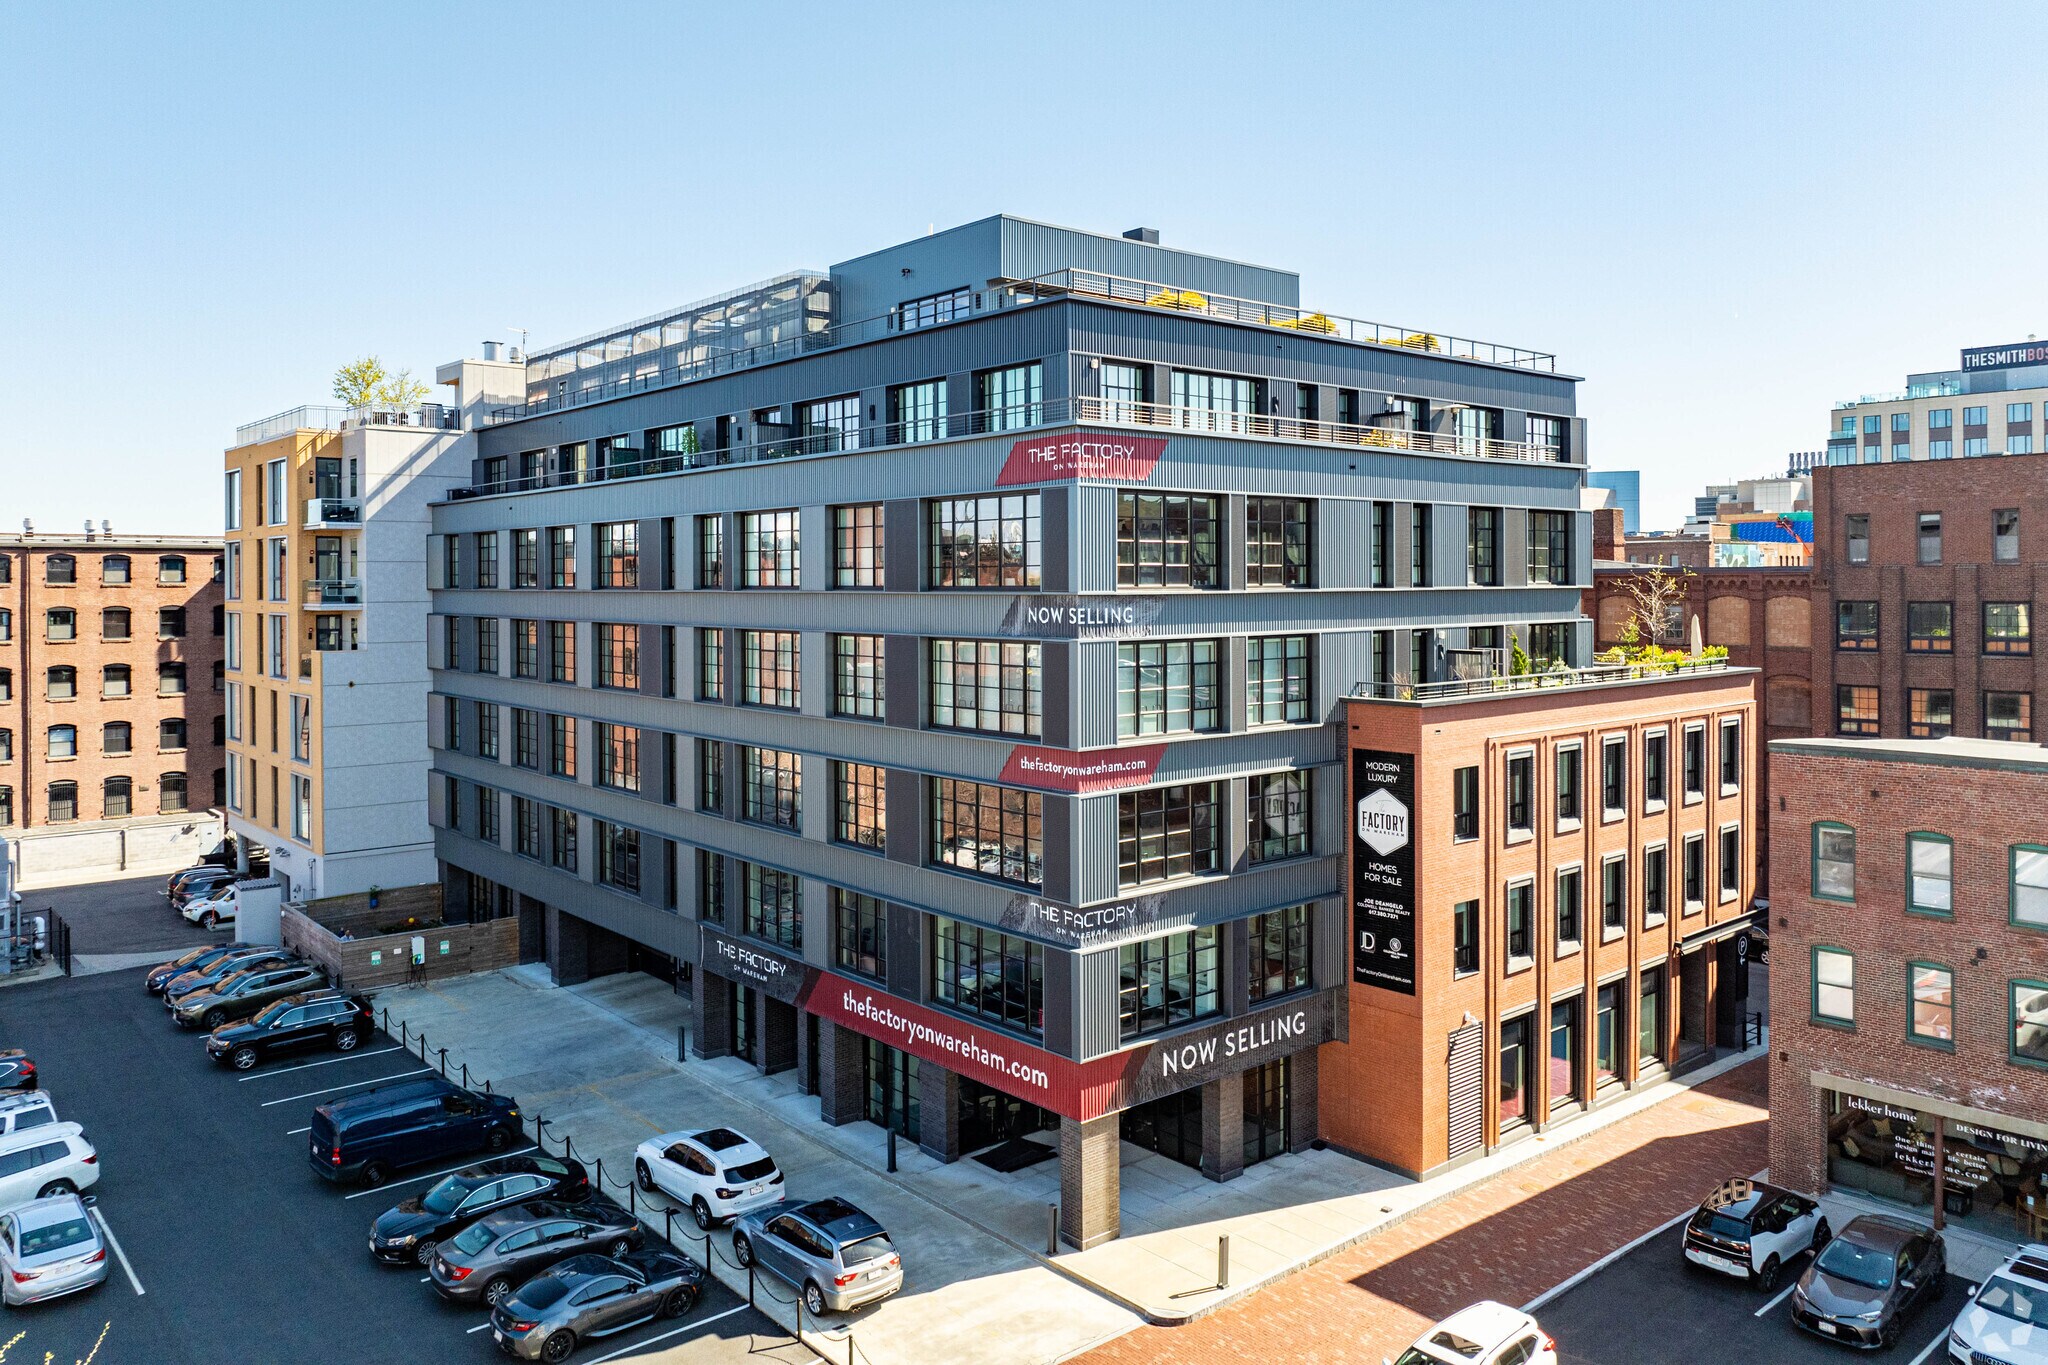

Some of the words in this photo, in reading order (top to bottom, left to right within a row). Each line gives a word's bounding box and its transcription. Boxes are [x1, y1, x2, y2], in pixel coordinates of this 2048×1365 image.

[1028, 446, 1057, 464] THE
[1060, 442, 1134, 460] FACTORY
[1028, 607, 1063, 624] NOW
[1069, 607, 1132, 624] SELLING
[1020, 756, 1146, 779] thefactoryonwareham.com
[1366, 762, 1400, 772] MODERN
[1368, 772, 1398, 784] LUXURY
[1362, 810, 1404, 832] FACTORY
[1364, 872, 1380, 882] FOR
[1382, 875, 1402, 886] SALE
[1368, 862, 1398, 874] HOMES
[1030, 902, 1060, 922] THE
[1064, 903, 1137, 928] FACTORY
[716, 940, 736, 959] THE
[738, 948, 786, 976] FACTORY
[843, 989, 1048, 1089] thefactoryonwareham.com
[1163, 1038, 1217, 1076] NOW
[1225, 1012, 1306, 1056] SELLING
[1848, 1096, 1882, 1114] lekker
[1884, 1104, 1917, 1123] home
[1895, 1135, 1911, 1144] One
[1956, 1124, 1992, 1139] DESIGN
[1996, 1133, 2018, 1145] FOR
[1894, 1142, 1919, 1153] design
[1964, 1159, 1986, 1170] better
